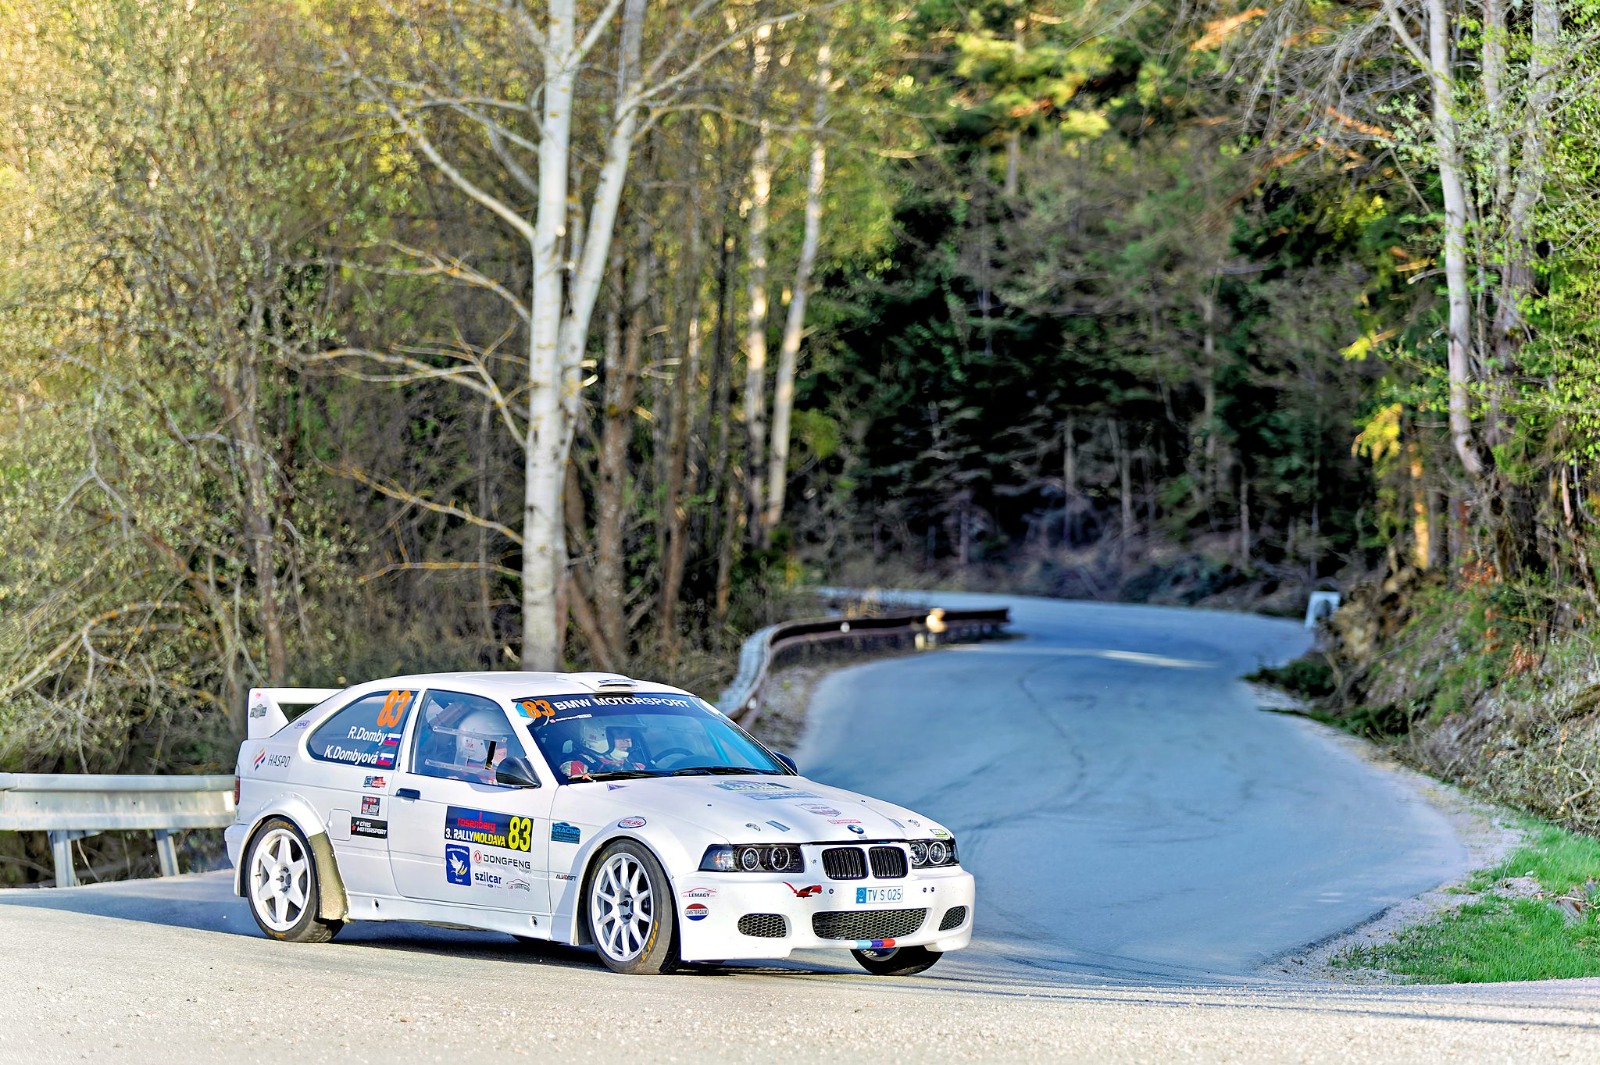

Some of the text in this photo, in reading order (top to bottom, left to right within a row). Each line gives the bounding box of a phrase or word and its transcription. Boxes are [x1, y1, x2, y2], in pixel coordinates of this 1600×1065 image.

[377, 690, 411, 727] 83
[522, 700, 556, 718] 83
[553, 697, 690, 710] BMW MOTORSPORT
[347, 726, 387, 746] R.Domby
[267, 754, 291, 768] HASPO
[324, 745, 379, 765] K.Dombyová
[457, 812, 496, 833] rosenberg
[445, 828, 506, 847] 3. RALLYMOLDAVA
[509, 816, 532, 852] 83
[483, 854, 531, 869] DONGFENG
[474, 872, 502, 884] szilcar
[867, 888, 902, 901] TV S 025
